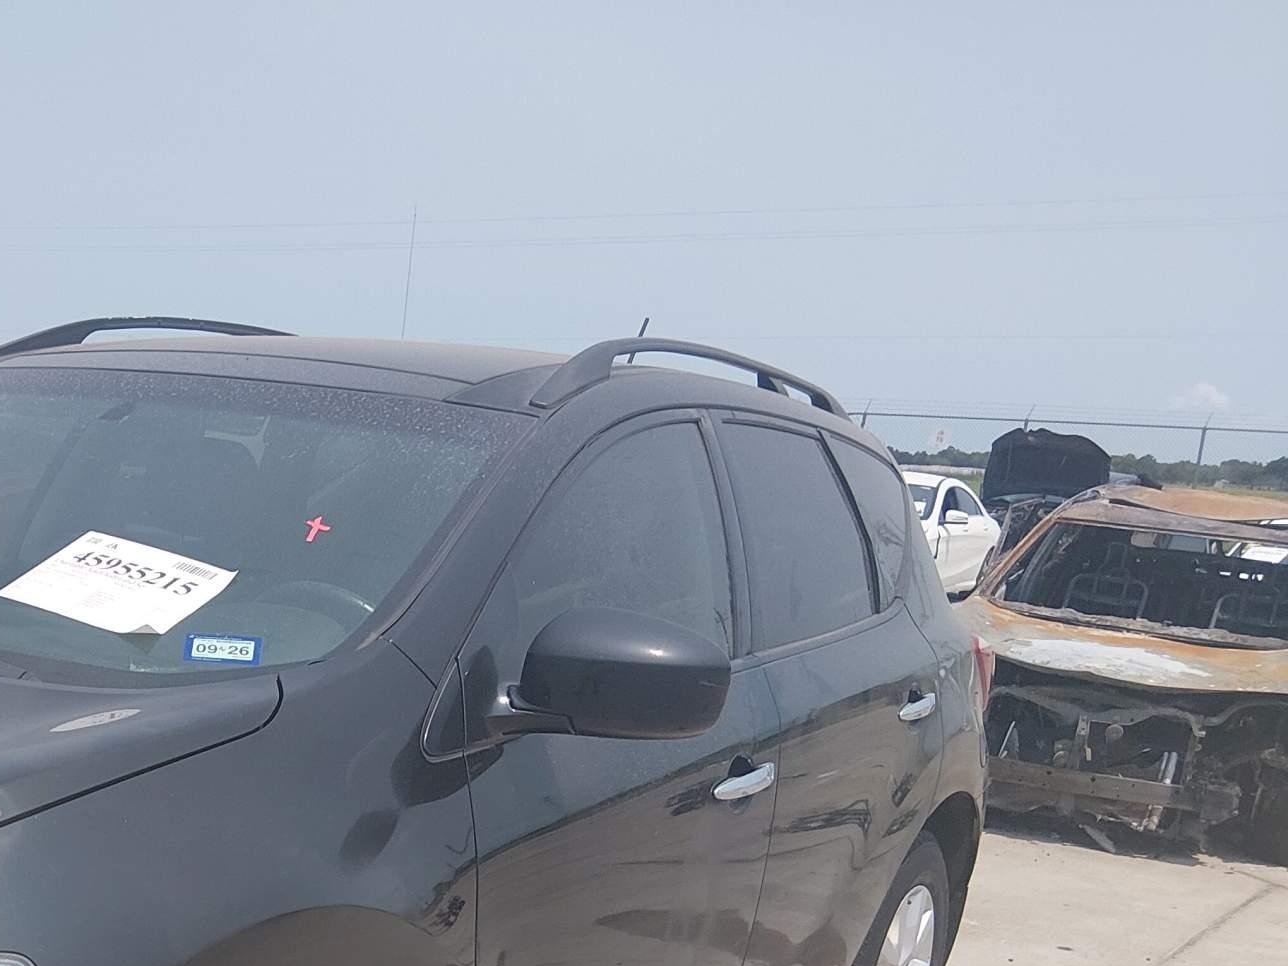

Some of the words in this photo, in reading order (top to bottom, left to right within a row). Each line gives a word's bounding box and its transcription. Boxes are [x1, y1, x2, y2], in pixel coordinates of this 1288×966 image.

[73, 551, 199, 595] 45955215
[196, 643, 218, 654] 09
[227, 645, 250, 656] 26
